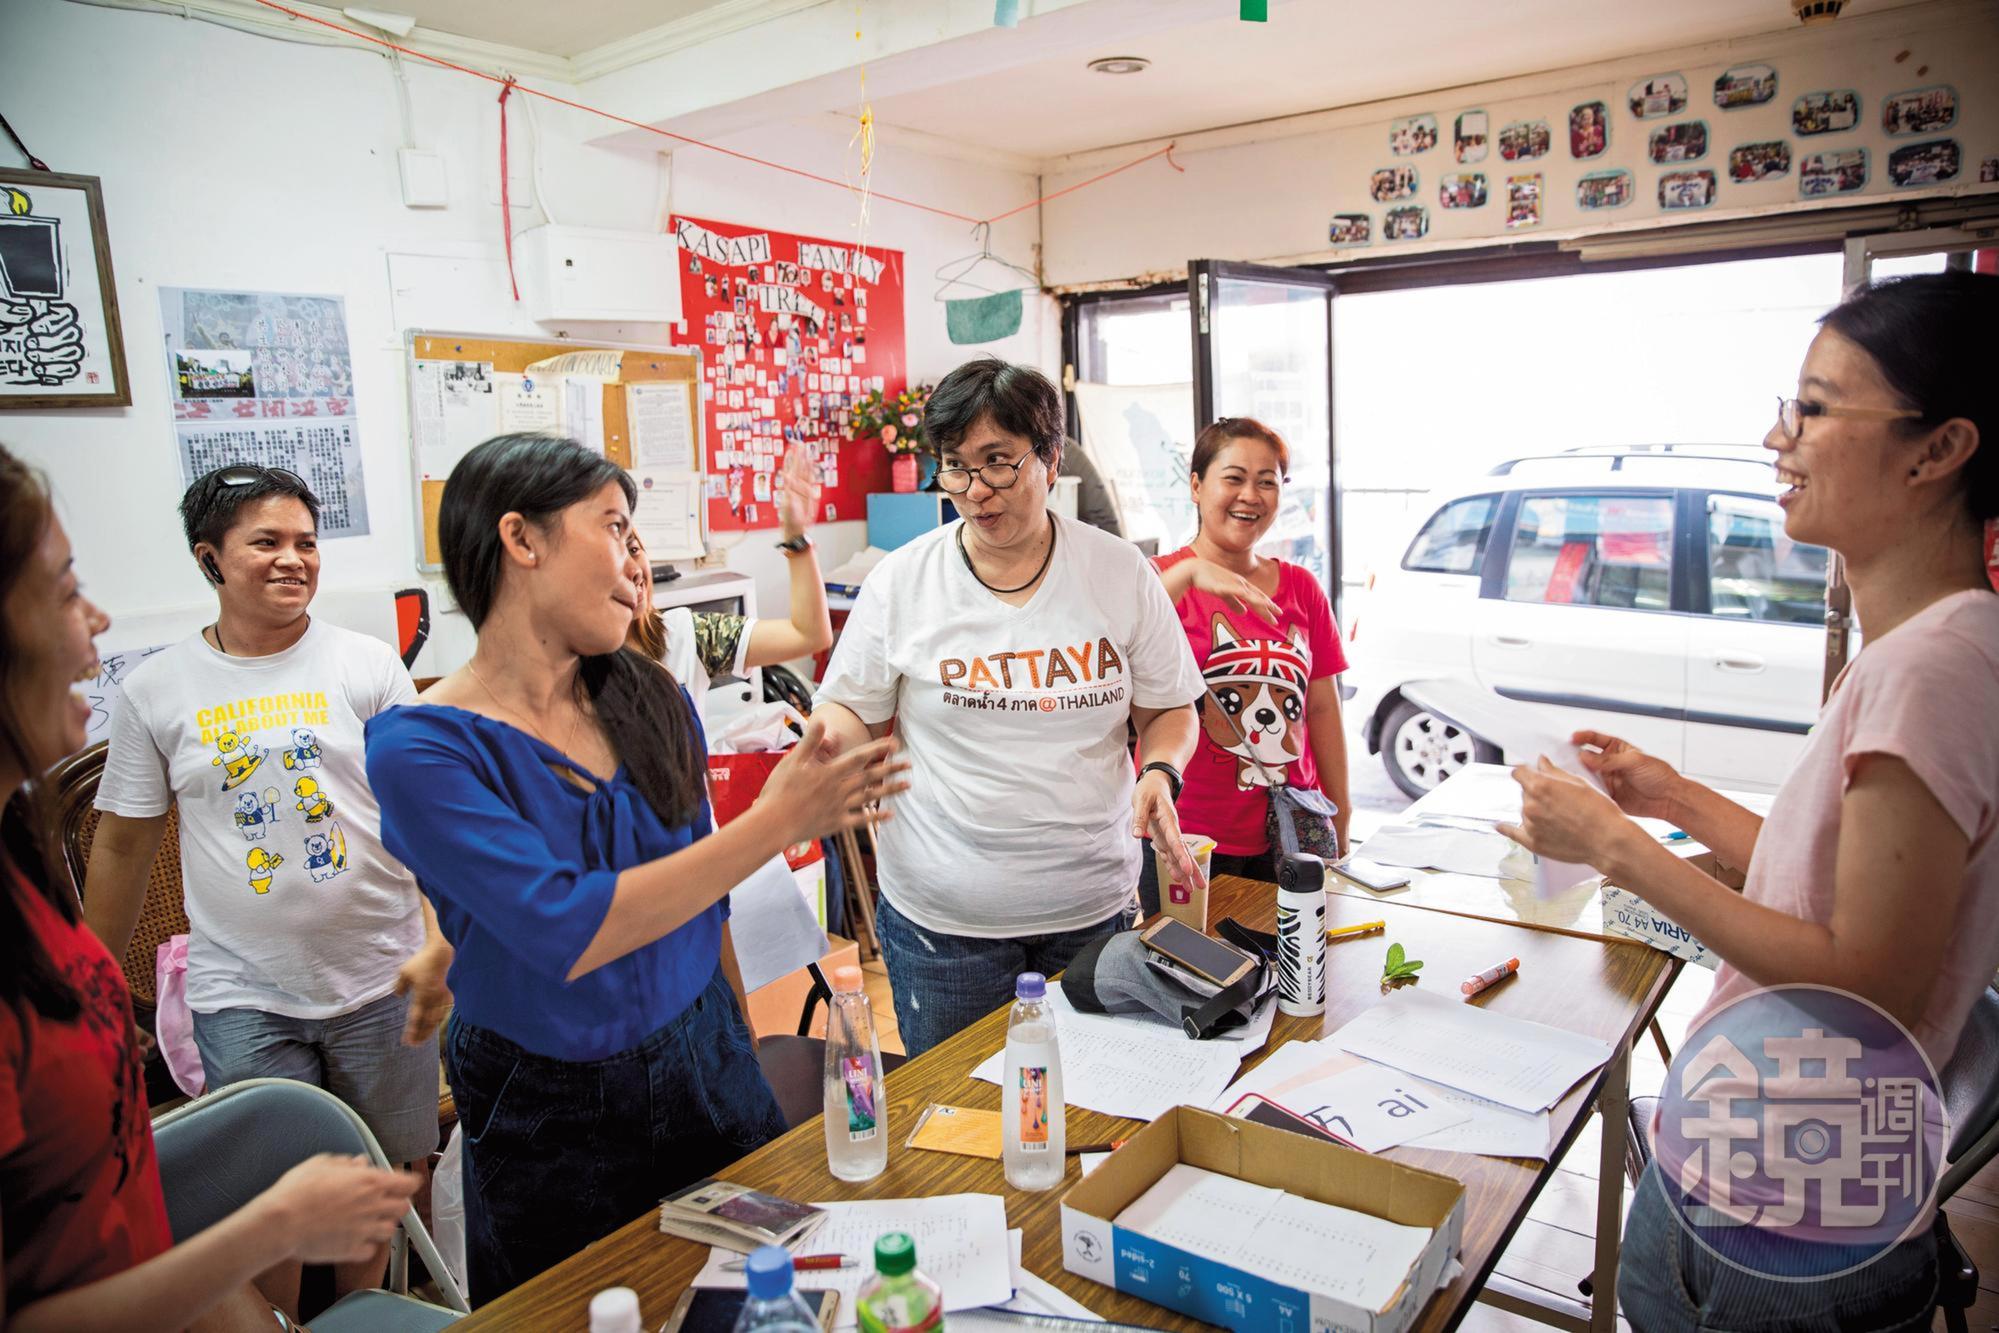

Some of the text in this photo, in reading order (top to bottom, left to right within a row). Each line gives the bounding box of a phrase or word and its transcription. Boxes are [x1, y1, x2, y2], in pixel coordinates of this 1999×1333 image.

[676, 220, 769, 265] KASAPI
[939, 637, 1123, 690] PATTAYA
[196, 691, 329, 728] CALIFORNIA
[996, 698, 1007, 711] 4
[235, 711, 298, 736] ABOUT
[303, 710, 330, 726] ME
[1618, 911, 1632, 926] 70
[1635, 917, 1649, 930] A4
[1377, 1088, 1430, 1118] ai
[1121, 1249, 1155, 1269] 2-sided
[1178, 1269, 1191, 1282] 70
[1216, 1282, 1234, 1296] 500
[1278, 1305, 1293, 1317] A4
